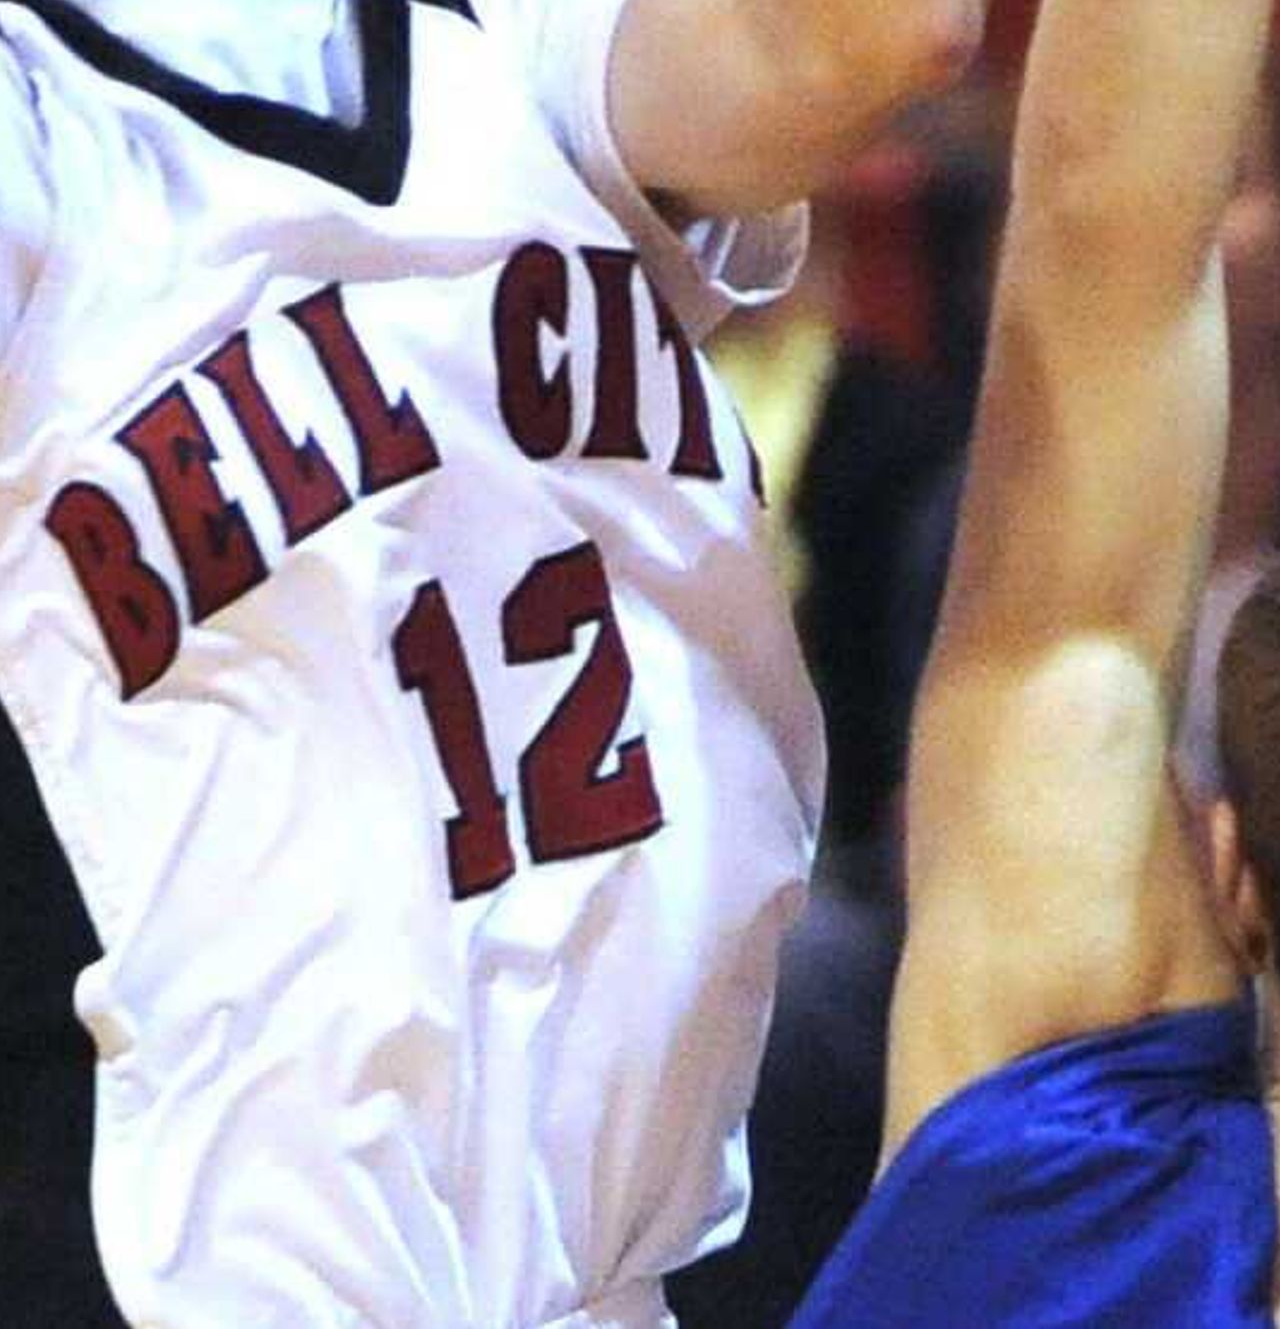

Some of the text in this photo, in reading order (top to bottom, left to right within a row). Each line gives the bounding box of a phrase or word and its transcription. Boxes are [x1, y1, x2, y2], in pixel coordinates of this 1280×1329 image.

[45, 239, 767, 703] BELL CIT
[392, 540, 665, 902] 12
